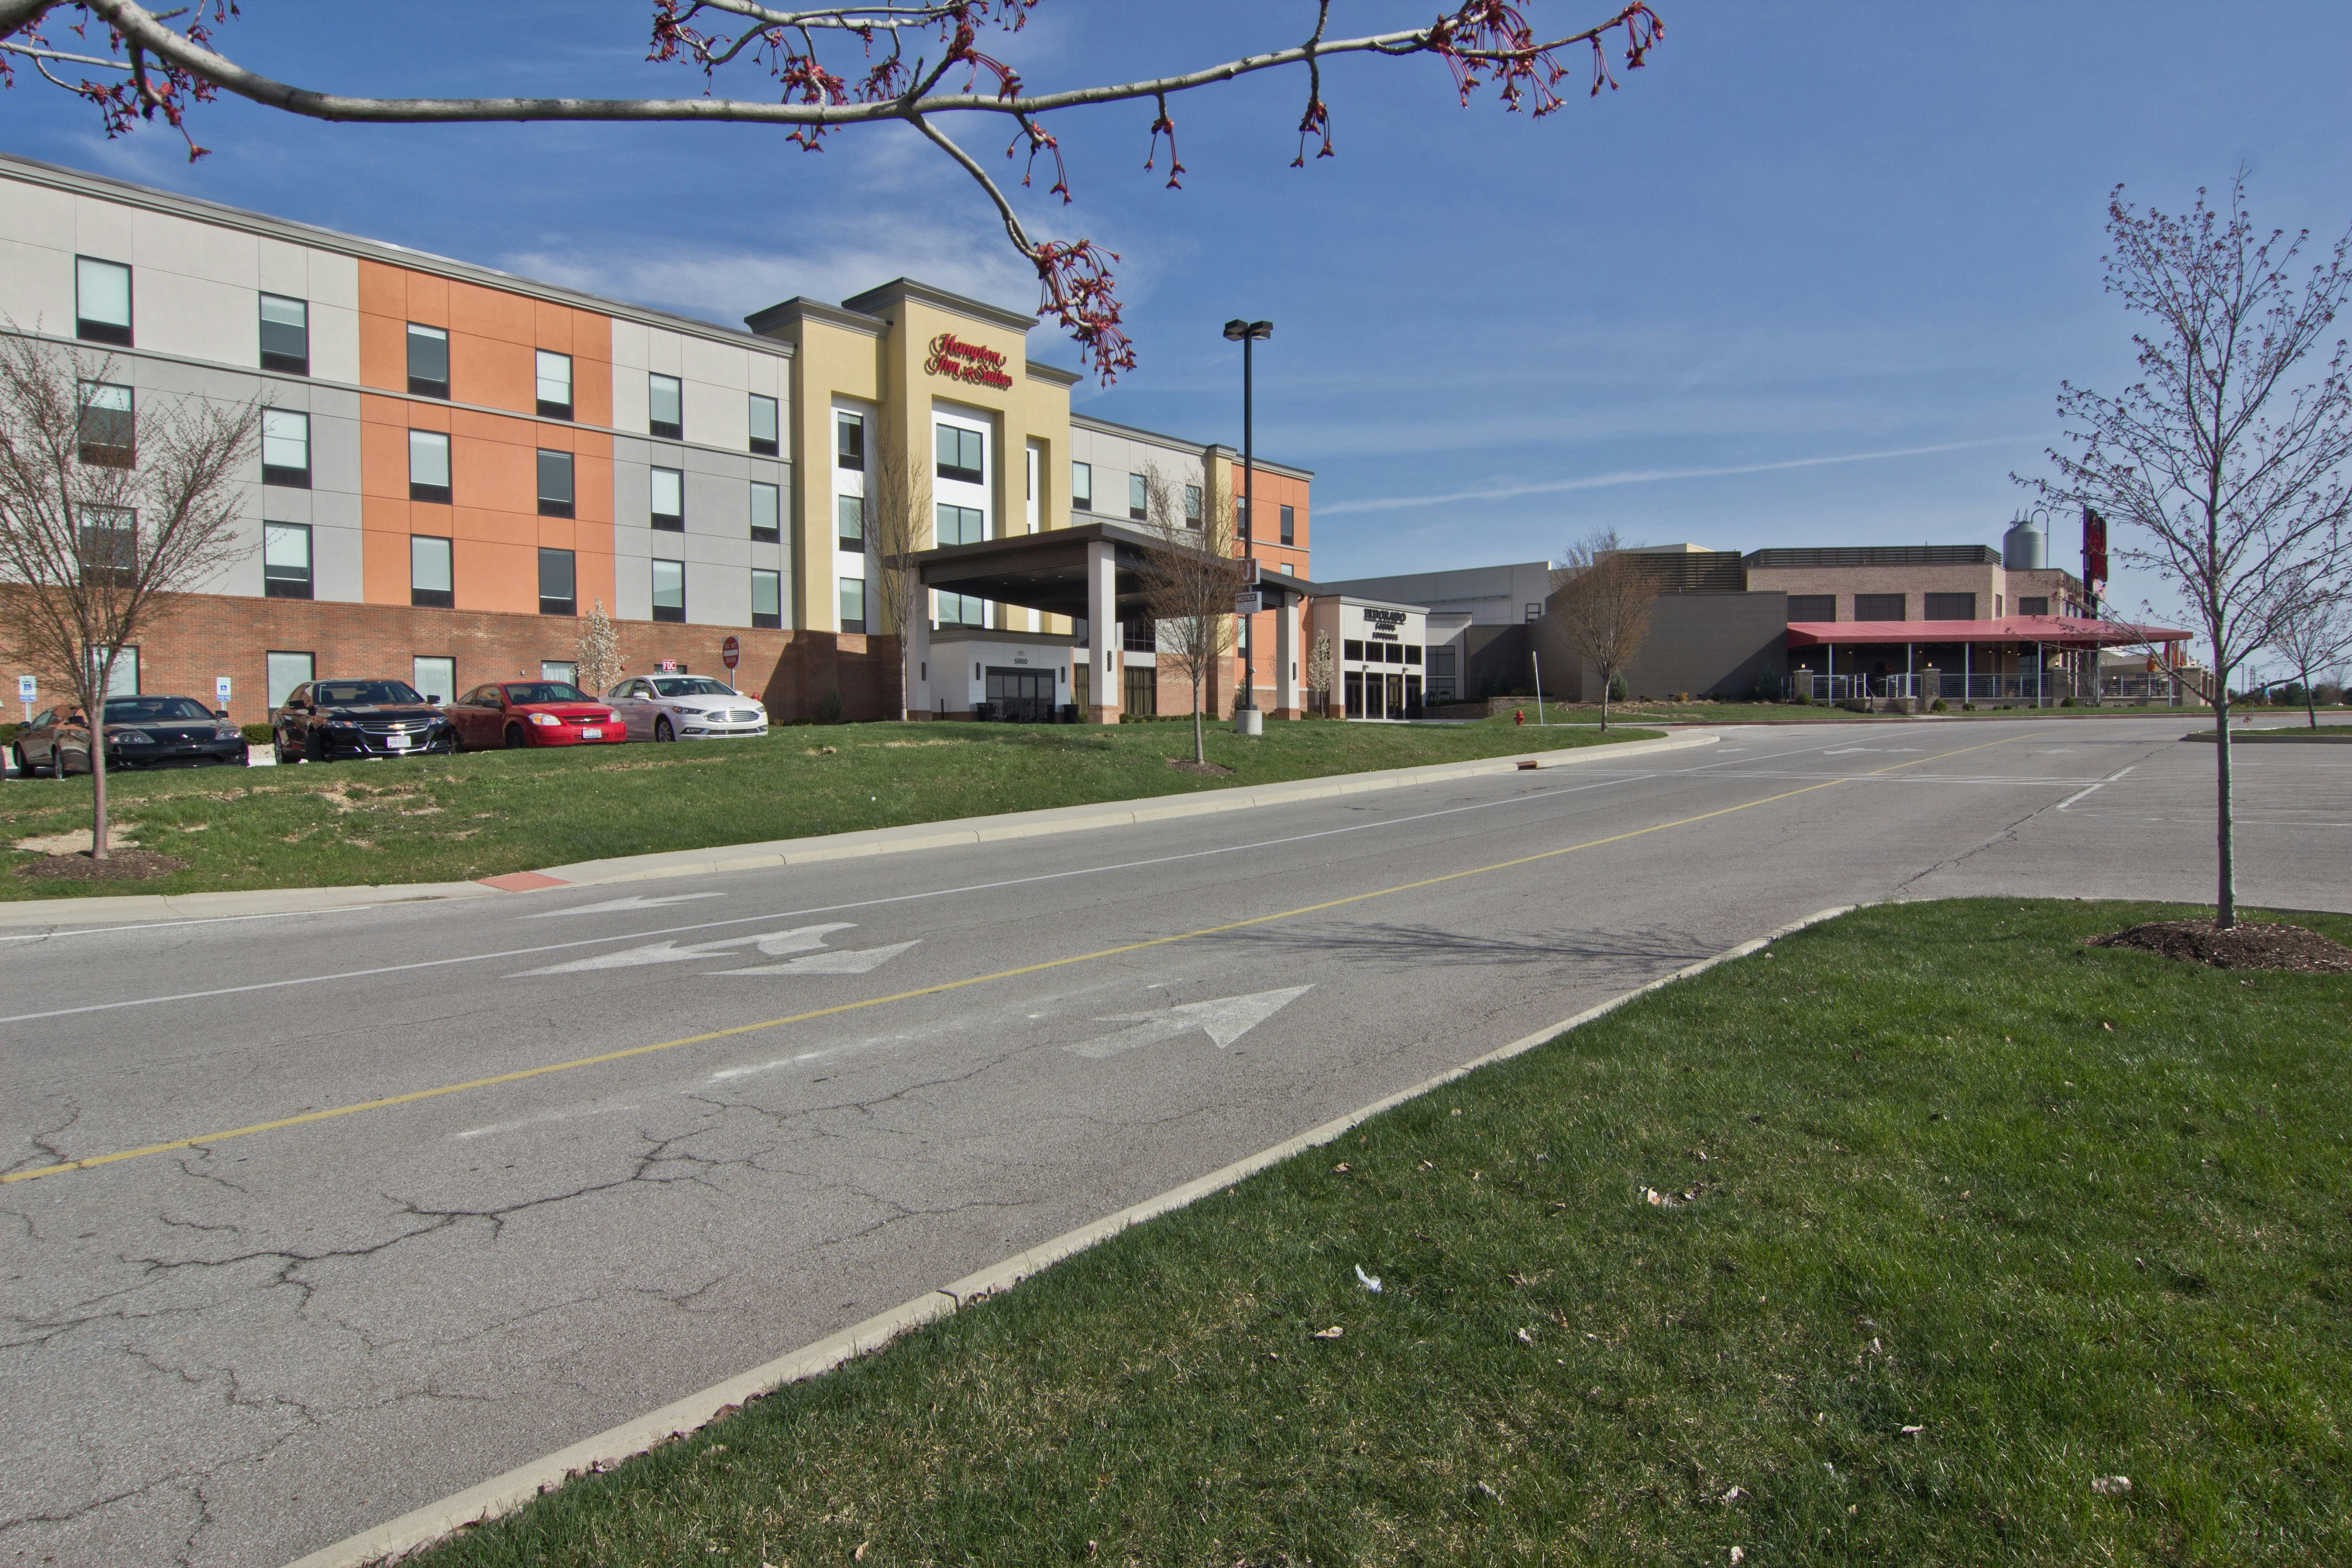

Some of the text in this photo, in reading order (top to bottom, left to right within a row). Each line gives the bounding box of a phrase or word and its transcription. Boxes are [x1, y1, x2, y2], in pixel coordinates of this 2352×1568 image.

[932, 333, 1007, 367] Hampton
[928, 354, 966, 377] Inn
[972, 364, 1013, 387] Suites
[1242, 562, 1251, 580] J
[664, 661, 675, 670] FDC
